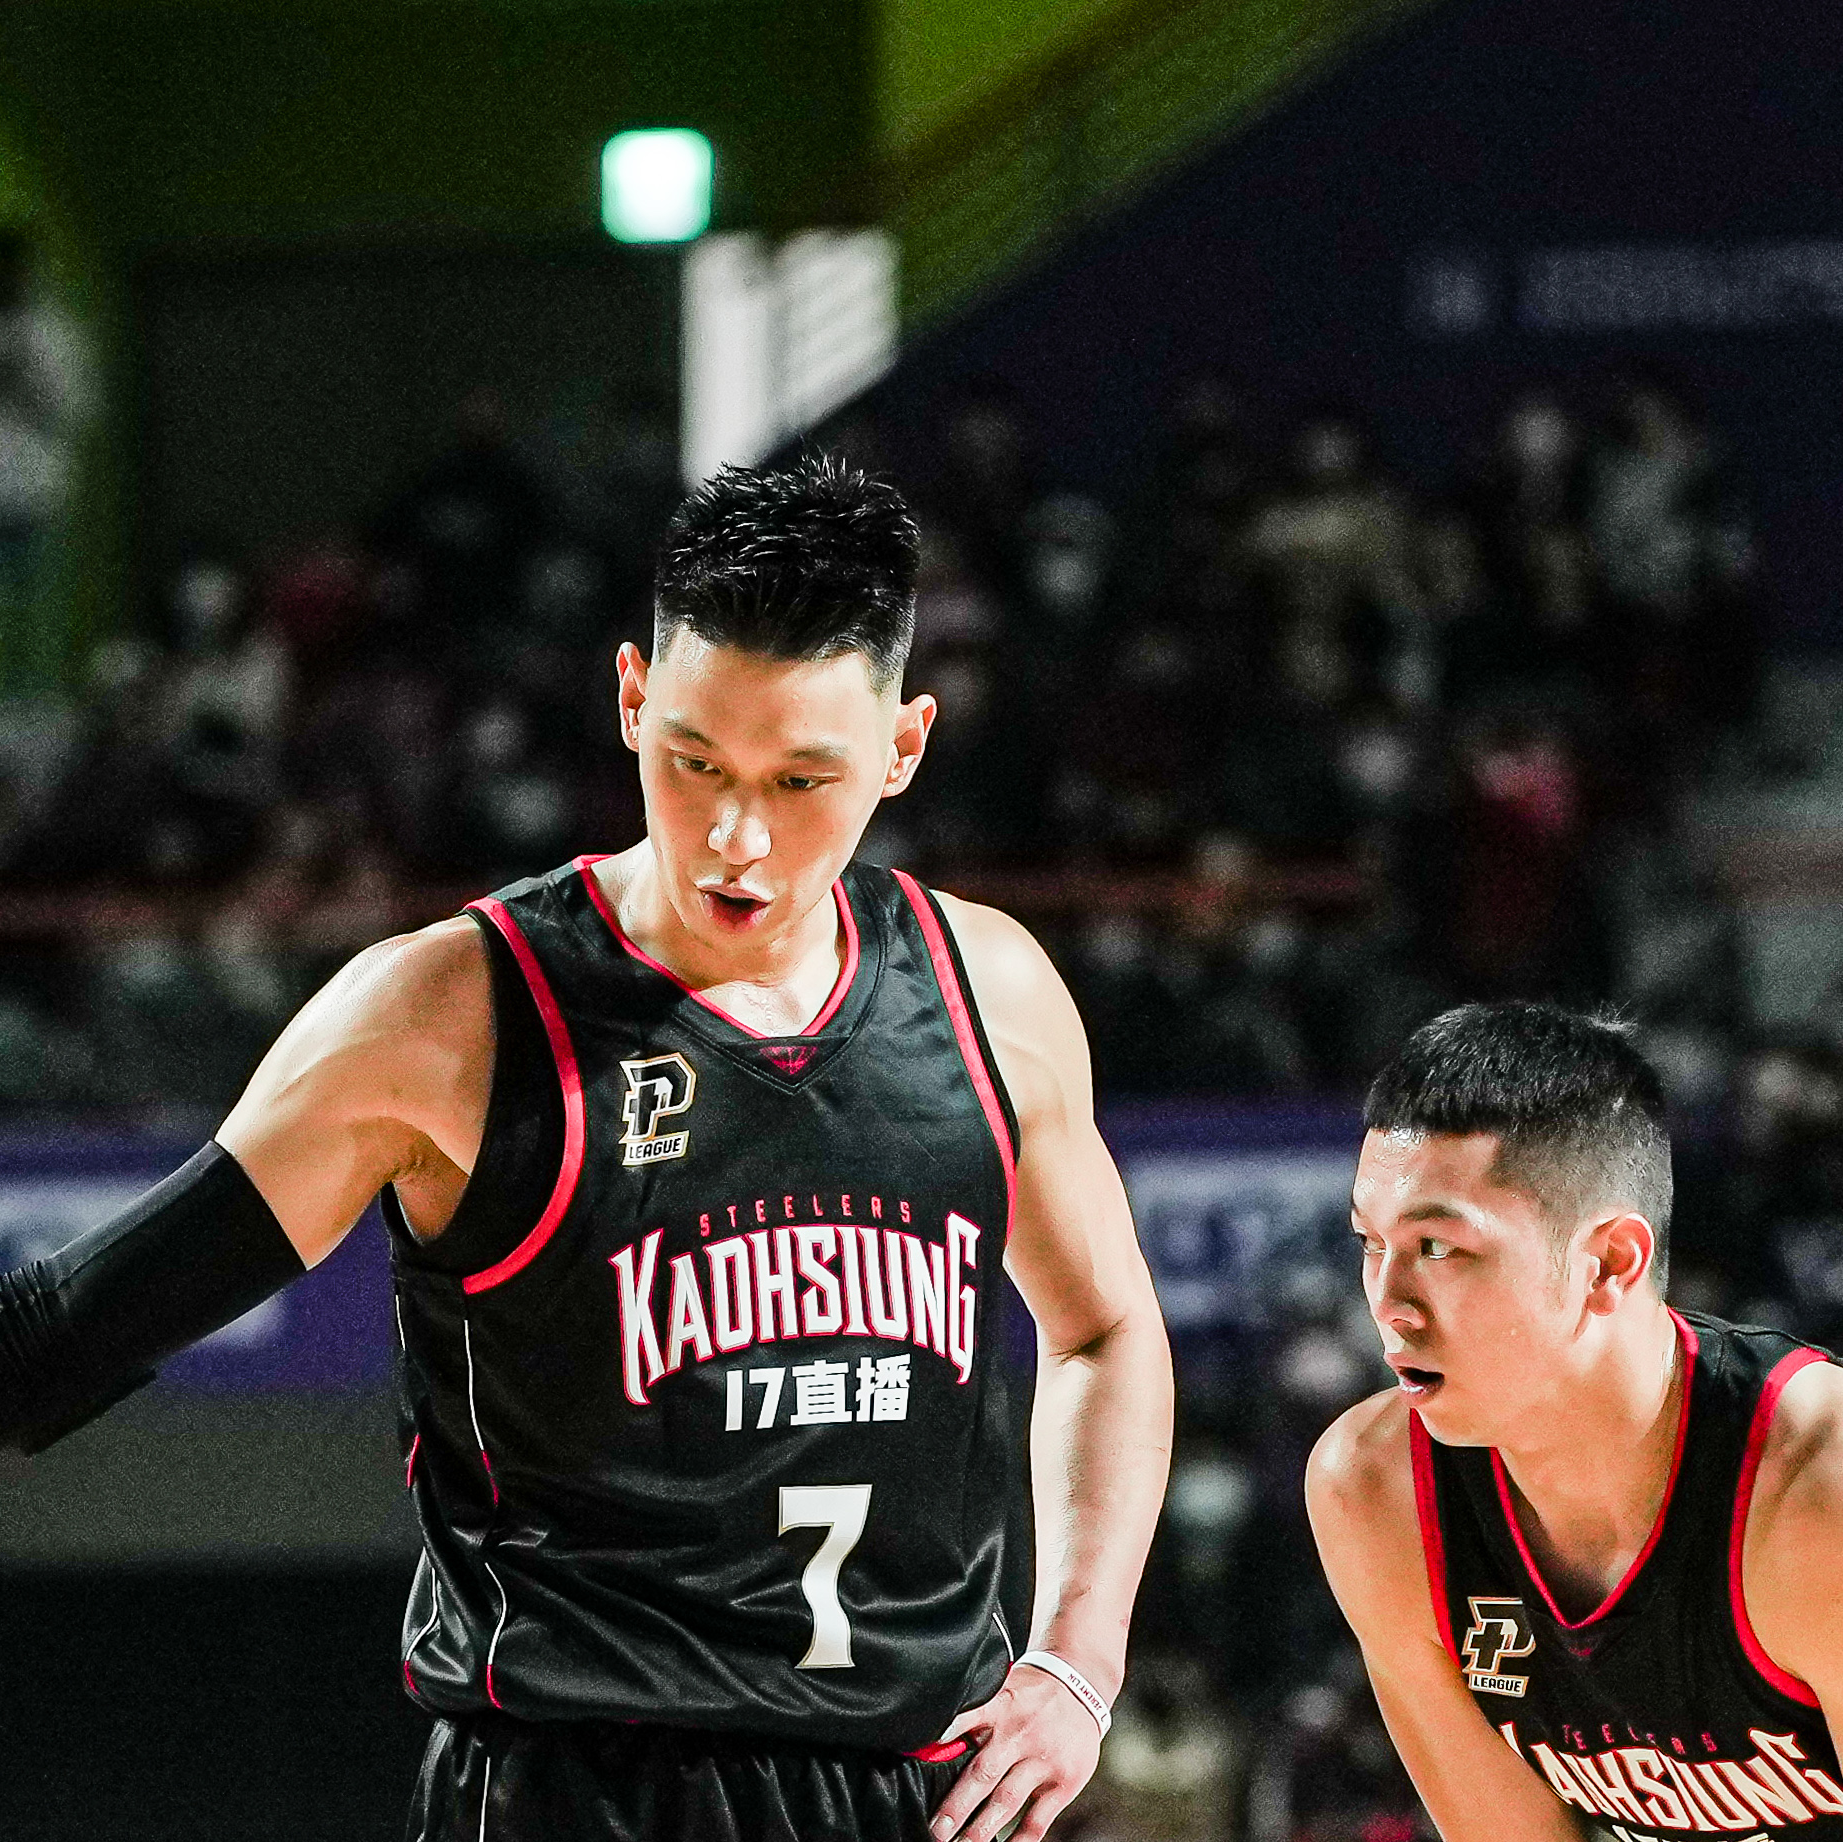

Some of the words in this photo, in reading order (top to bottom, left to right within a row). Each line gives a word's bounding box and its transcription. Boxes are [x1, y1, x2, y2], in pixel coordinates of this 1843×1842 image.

[629, 1137, 682, 1159] LEAGUE
[699, 1194, 912, 1237] STEELERS
[608, 1211, 981, 1405] KAOHSIUNG
[725, 1353, 911, 1432] 17直播
[778, 1484, 873, 1669] 7
[1473, 1676, 1522, 1692] LEAGUE
